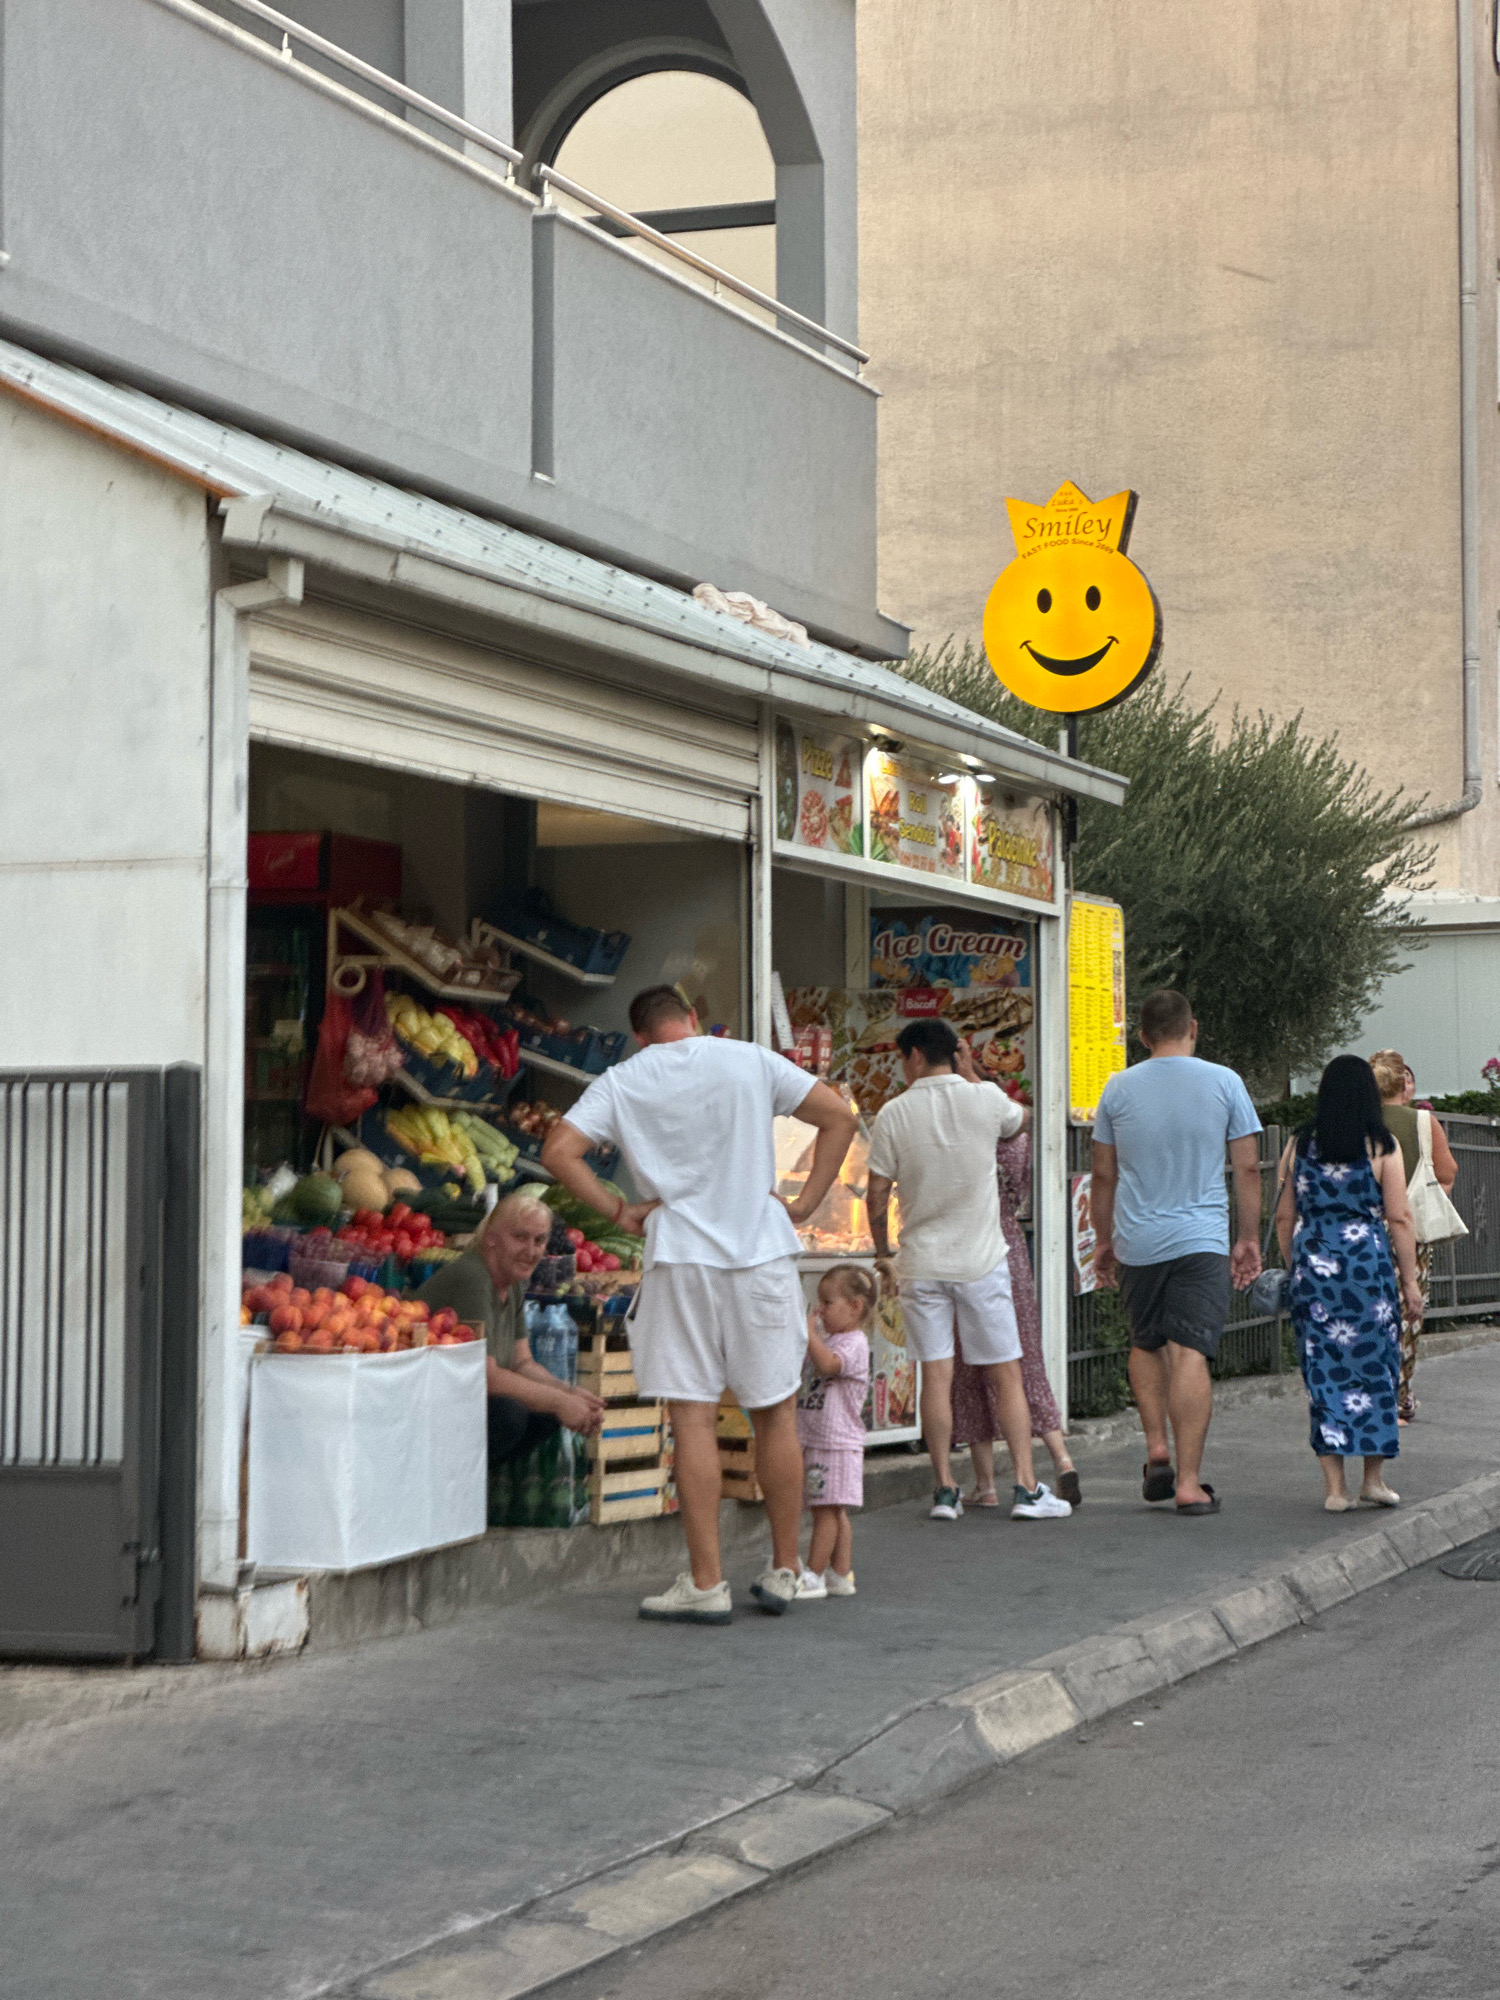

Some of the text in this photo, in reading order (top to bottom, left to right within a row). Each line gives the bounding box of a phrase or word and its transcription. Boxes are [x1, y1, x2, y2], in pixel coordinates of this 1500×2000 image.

[1023, 511, 1112, 542] Smiley
[1021, 545, 1042, 559] FAST
[1043, 538, 1069, 549] FOOD
[1071, 538, 1094, 547] Since
[875, 924, 1027, 960] Ice Cream
